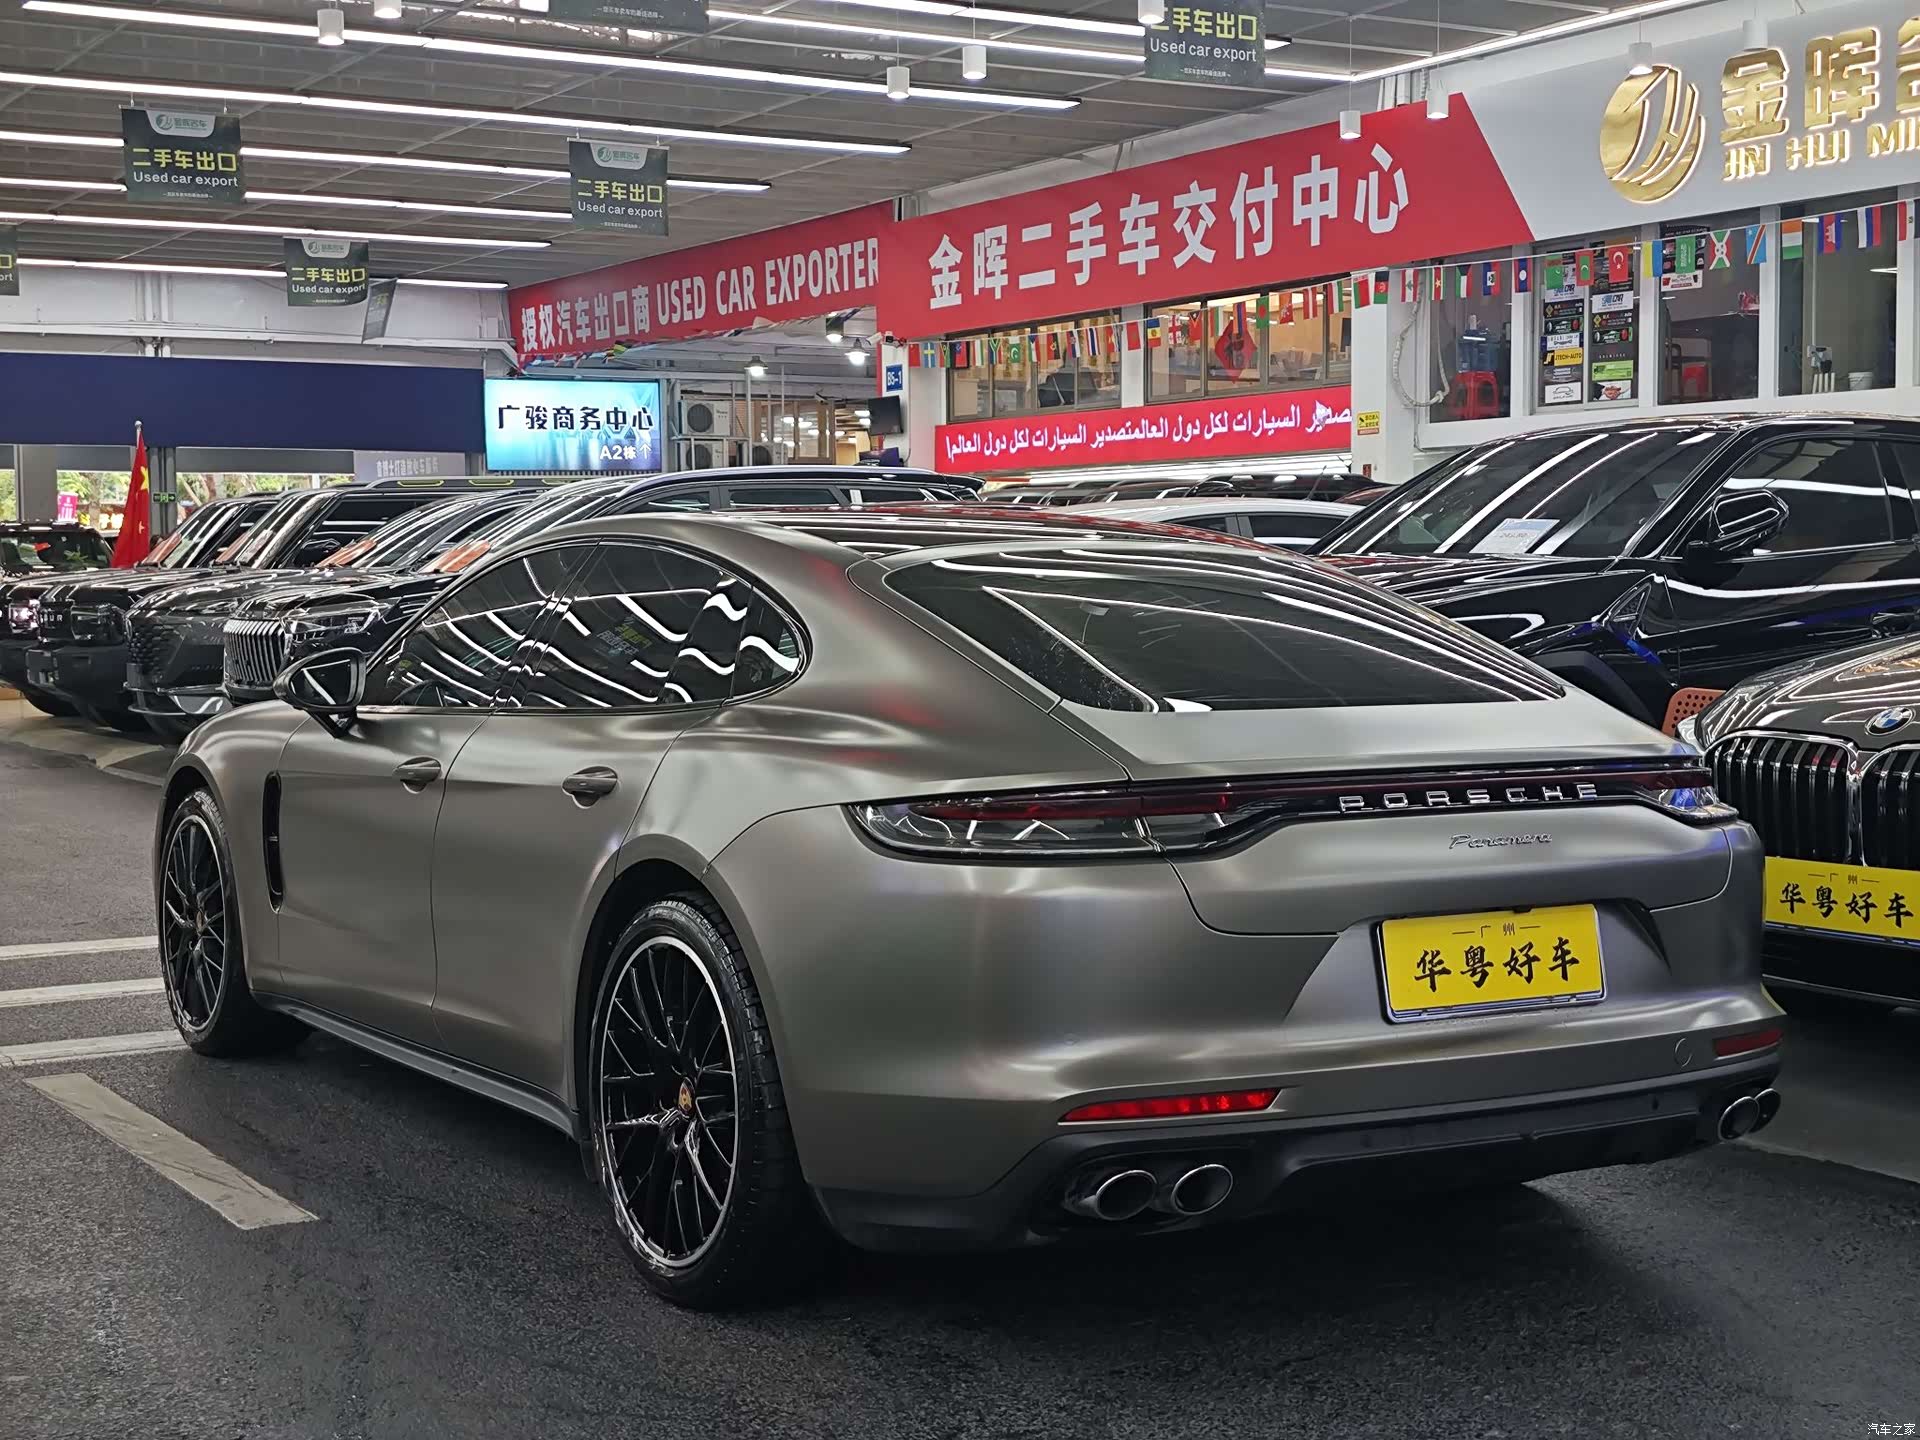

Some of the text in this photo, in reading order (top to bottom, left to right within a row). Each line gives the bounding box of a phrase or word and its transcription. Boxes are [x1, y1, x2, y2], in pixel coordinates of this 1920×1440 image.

[1150, 38, 1257, 62] Used car export
[133, 148, 237, 172] 二手车出口
[1785, 129, 1850, 171] HUI
[133, 171, 238, 187] Used car export
[577, 179, 663, 203] 二手车出口
[578, 201, 663, 218] Used car export
[928, 142, 1409, 310] 金晖二手车交付中心
[291, 267, 366, 283] 二手车出口
[292, 283, 366, 295] Used car export
[521, 237, 879, 352] 授权汽车出口商 USED CAR EXPORTER
[498, 405, 653, 430] 广骏商务中心
[1172, 415, 1200, 442] دول
[1204, 411, 1228, 440] لكل
[1232, 404, 1300, 438] السيارات
[984, 430, 1007, 456] دول
[1009, 427, 1029, 453] لكل
[1032, 423, 1087, 452] السيارات
[600, 444, 638, 460] A2栋
[1339, 783, 1598, 813] PORSCHE
[1449, 830, 1552, 850] Panamera
[1830, 872, 1858, 885] 广州
[1779, 882, 1914, 929] 华粤好车
[1480, 922, 1516, 938] 广州
[1414, 937, 1580, 993] 华粤好车
